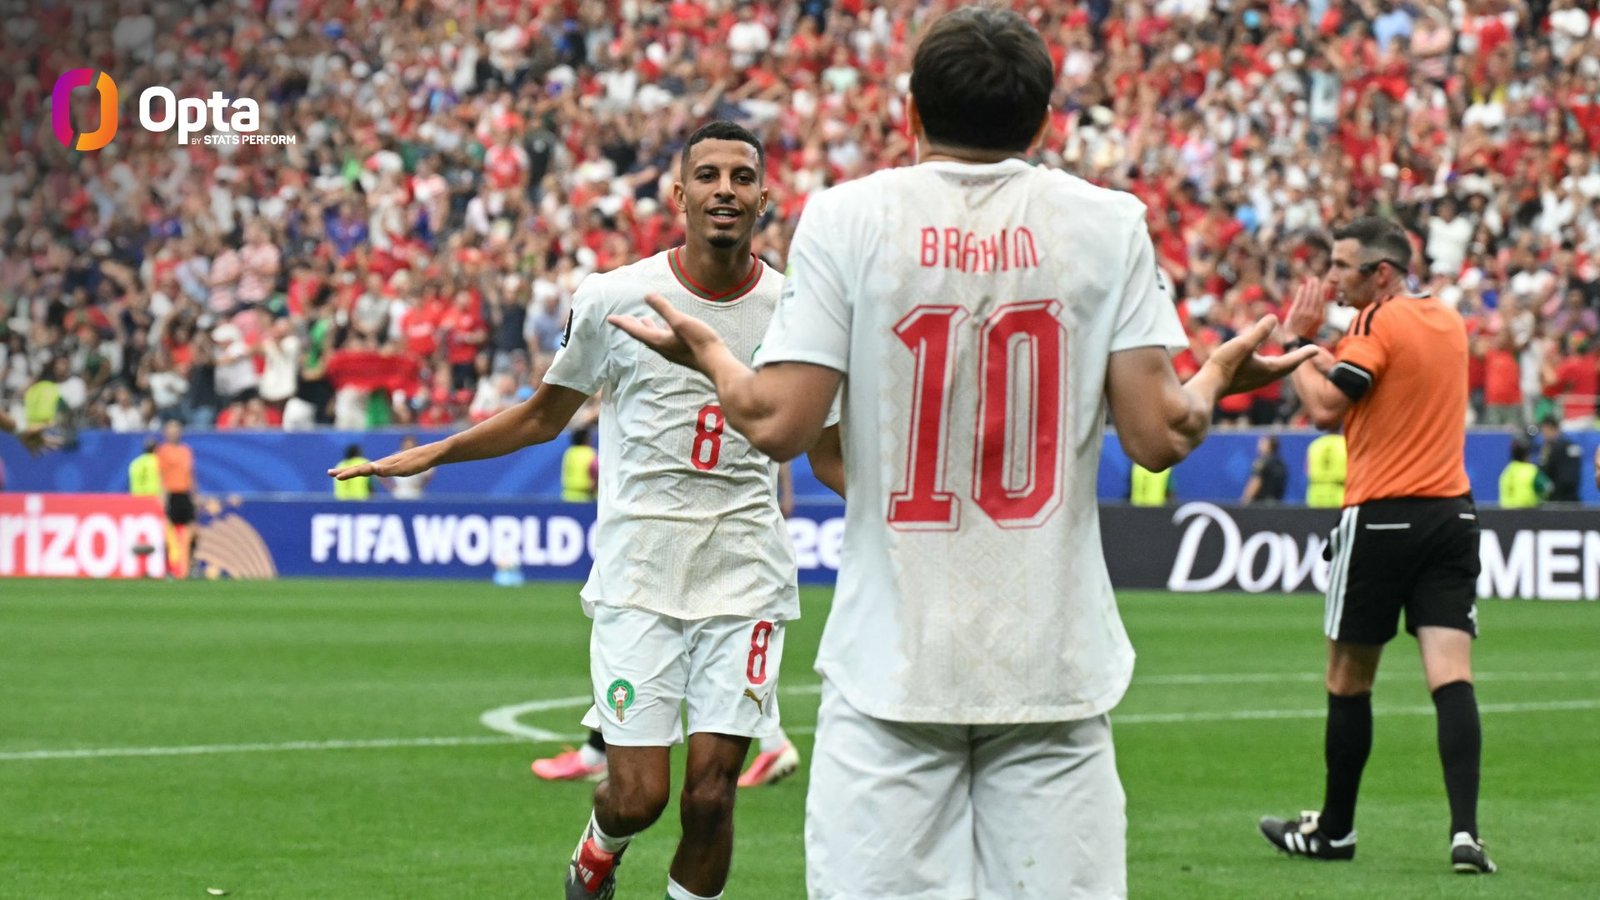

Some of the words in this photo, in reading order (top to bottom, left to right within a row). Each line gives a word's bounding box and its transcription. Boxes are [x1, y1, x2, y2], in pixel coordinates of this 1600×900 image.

[920, 226, 1038, 272] BRAHIM
[690, 405, 725, 470] 8
[887, 298, 1068, 531] 10
[311, 513, 411, 563] FIFA
[412, 514, 584, 566] WORLD
[746, 620, 773, 685] 8
